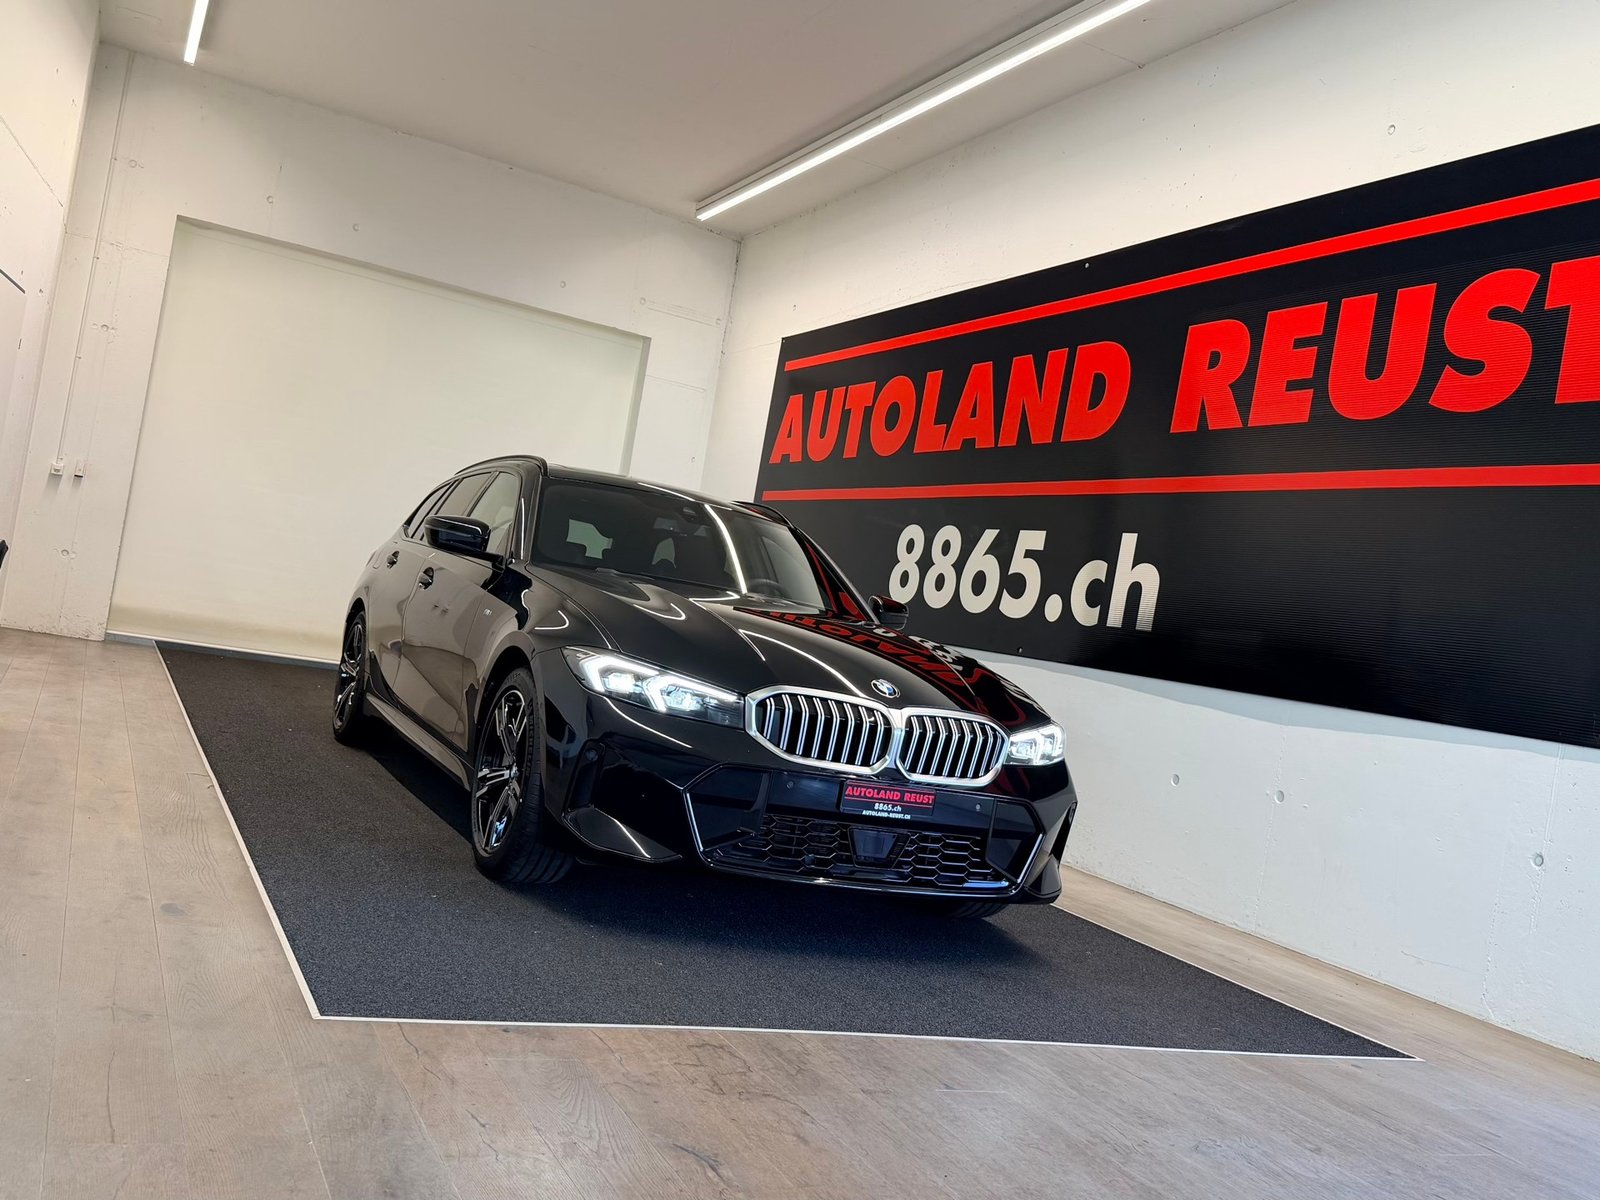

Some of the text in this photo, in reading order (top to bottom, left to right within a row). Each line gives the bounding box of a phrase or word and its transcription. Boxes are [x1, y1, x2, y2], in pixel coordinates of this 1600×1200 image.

[768, 254, 1600, 465] AUTOLAND REUST
[888, 523, 1161, 632] 8865.ch
[845, 786, 935, 804] AUTOLAND REUST
[874, 802, 902, 812] 8865.ch
